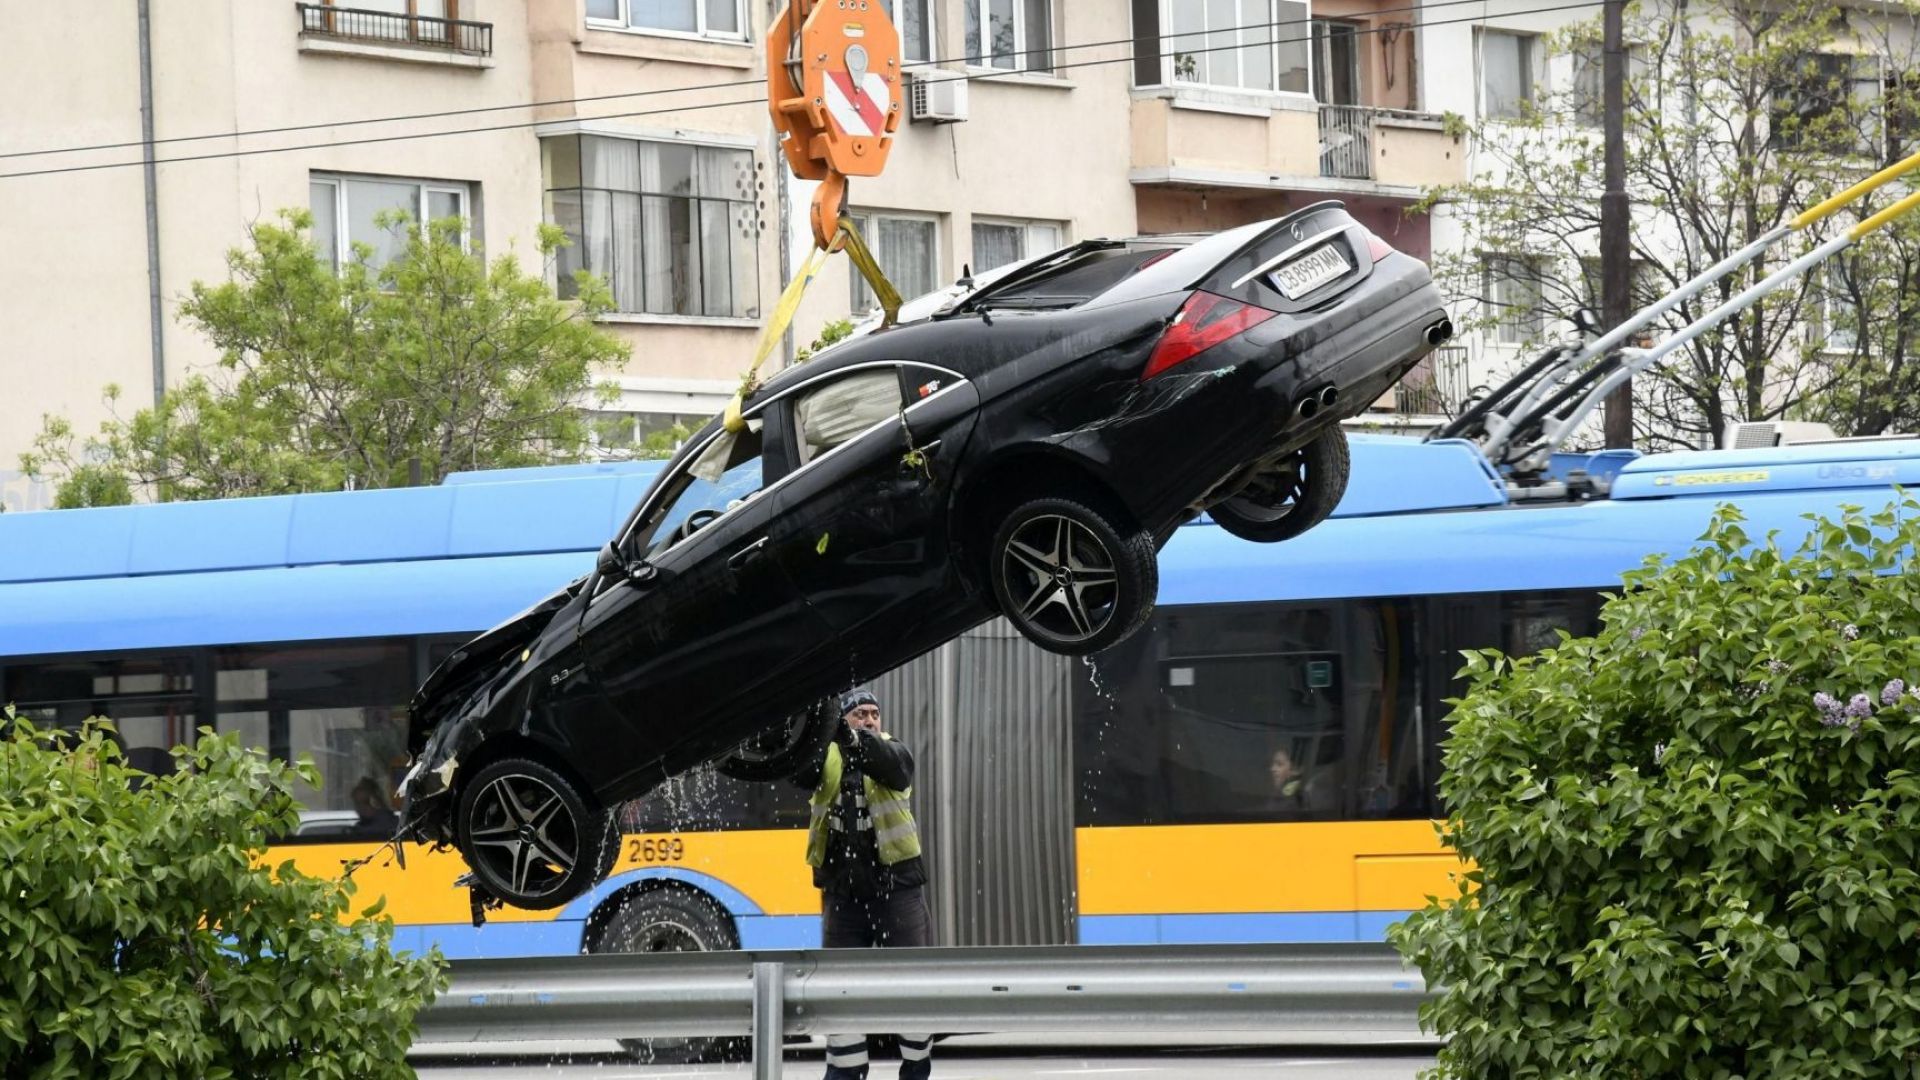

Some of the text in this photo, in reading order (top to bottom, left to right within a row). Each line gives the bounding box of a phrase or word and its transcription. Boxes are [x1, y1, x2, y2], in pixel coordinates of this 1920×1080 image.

[1294, 257, 1324, 283] 8999
[1320, 247, 1342, 271] MM
[629, 837, 684, 863] 2699
